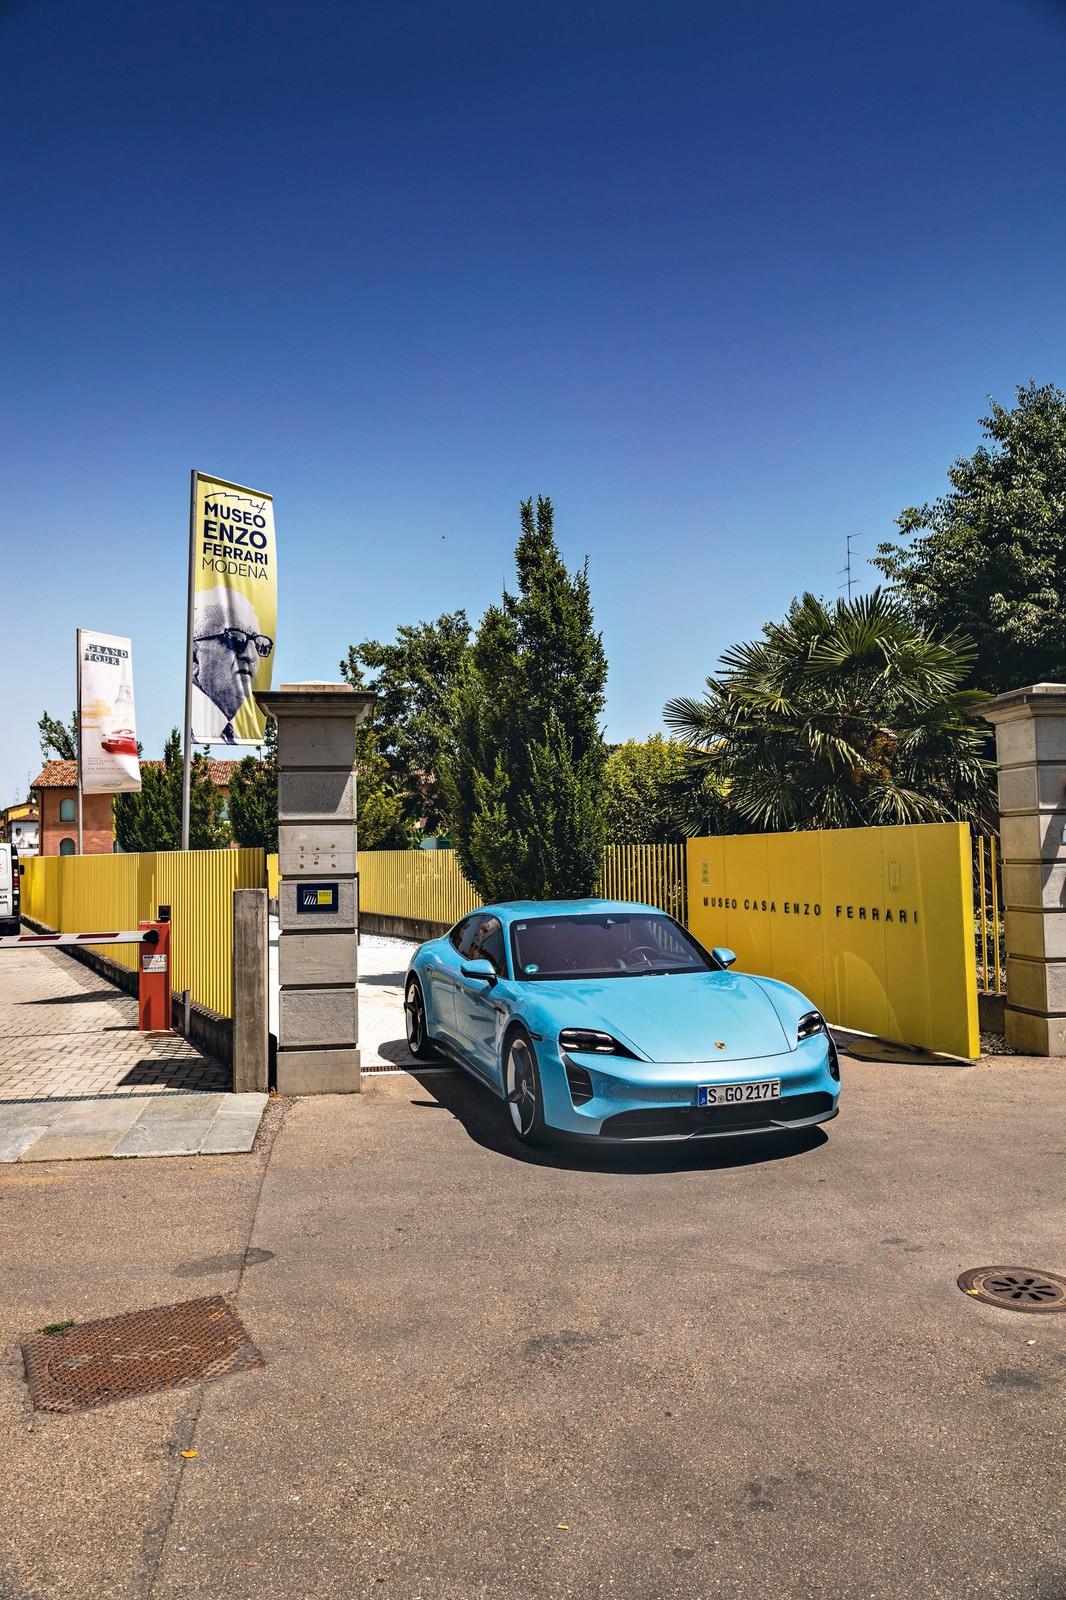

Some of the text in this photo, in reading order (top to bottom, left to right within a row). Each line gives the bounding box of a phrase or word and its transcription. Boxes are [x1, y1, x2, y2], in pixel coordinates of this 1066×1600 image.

[204, 501, 266, 528] MUSEO
[203, 519, 267, 549] ENZO
[203, 542, 268, 565] FERRARI
[202, 557, 268, 580] MODENA
[87, 654, 118, 665] TOUR
[88, 645, 127, 657] GRAND
[703, 897, 918, 923] MUSEO CASA ENZO FERRARI
[708, 1089, 717, 1103] S
